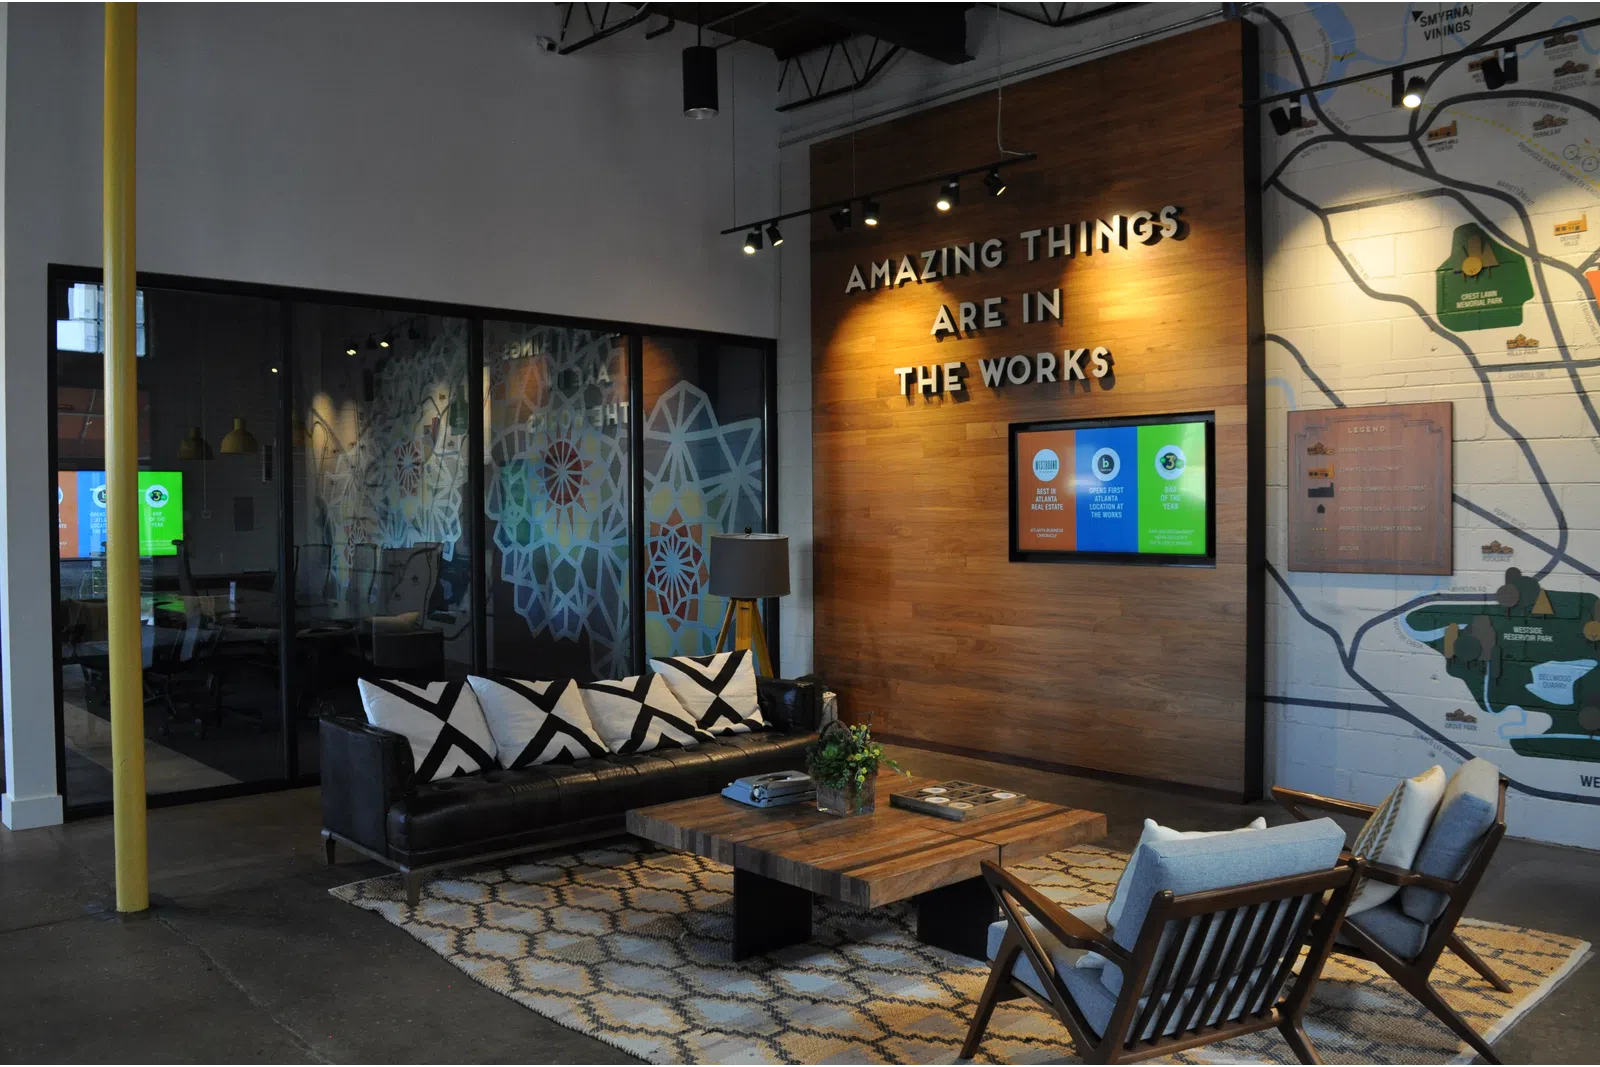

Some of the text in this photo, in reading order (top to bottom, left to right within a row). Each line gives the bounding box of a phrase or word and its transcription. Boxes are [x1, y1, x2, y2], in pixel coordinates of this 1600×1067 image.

[1420, 4, 1474, 28] SMYRNA/
[1424, 20, 1471, 41] VININGS
[844, 204, 1179, 293] AMAZING THINGS
[1460, 290, 1498, 300] CREST LAWN
[1456, 297, 1503, 309] MEMORIAL PARK
[930, 288, 1061, 336] ARE IN
[894, 346, 1110, 396] THE WORKS
[1347, 425, 1386, 434] LEGEND
[1035, 460, 1058, 471] WESTBOUND
[1165, 454, 1176, 470] 3
[1036, 487, 1057, 495] BEST IN
[1108, 486, 1124, 494] FIRST
[1164, 485, 1177, 493] BAR
[1035, 495, 1058, 503] ATLANTA
[1169, 494, 1181, 502] THE
[1031, 503, 1064, 511] REAL ESTATE
[1089, 503, 1116, 511] LOCATION
[1163, 502, 1179, 510] YEAR
[1091, 511, 1102, 519] THE
[1513, 626, 1543, 635] WESTSIDE
[1503, 633, 1554, 643] RESERVOIR PARK
[1538, 673, 1572, 682] BELLWOOD
[1542, 681, 1567, 690] QUARRY
[1444, 722, 1479, 732] GROVE PARK
